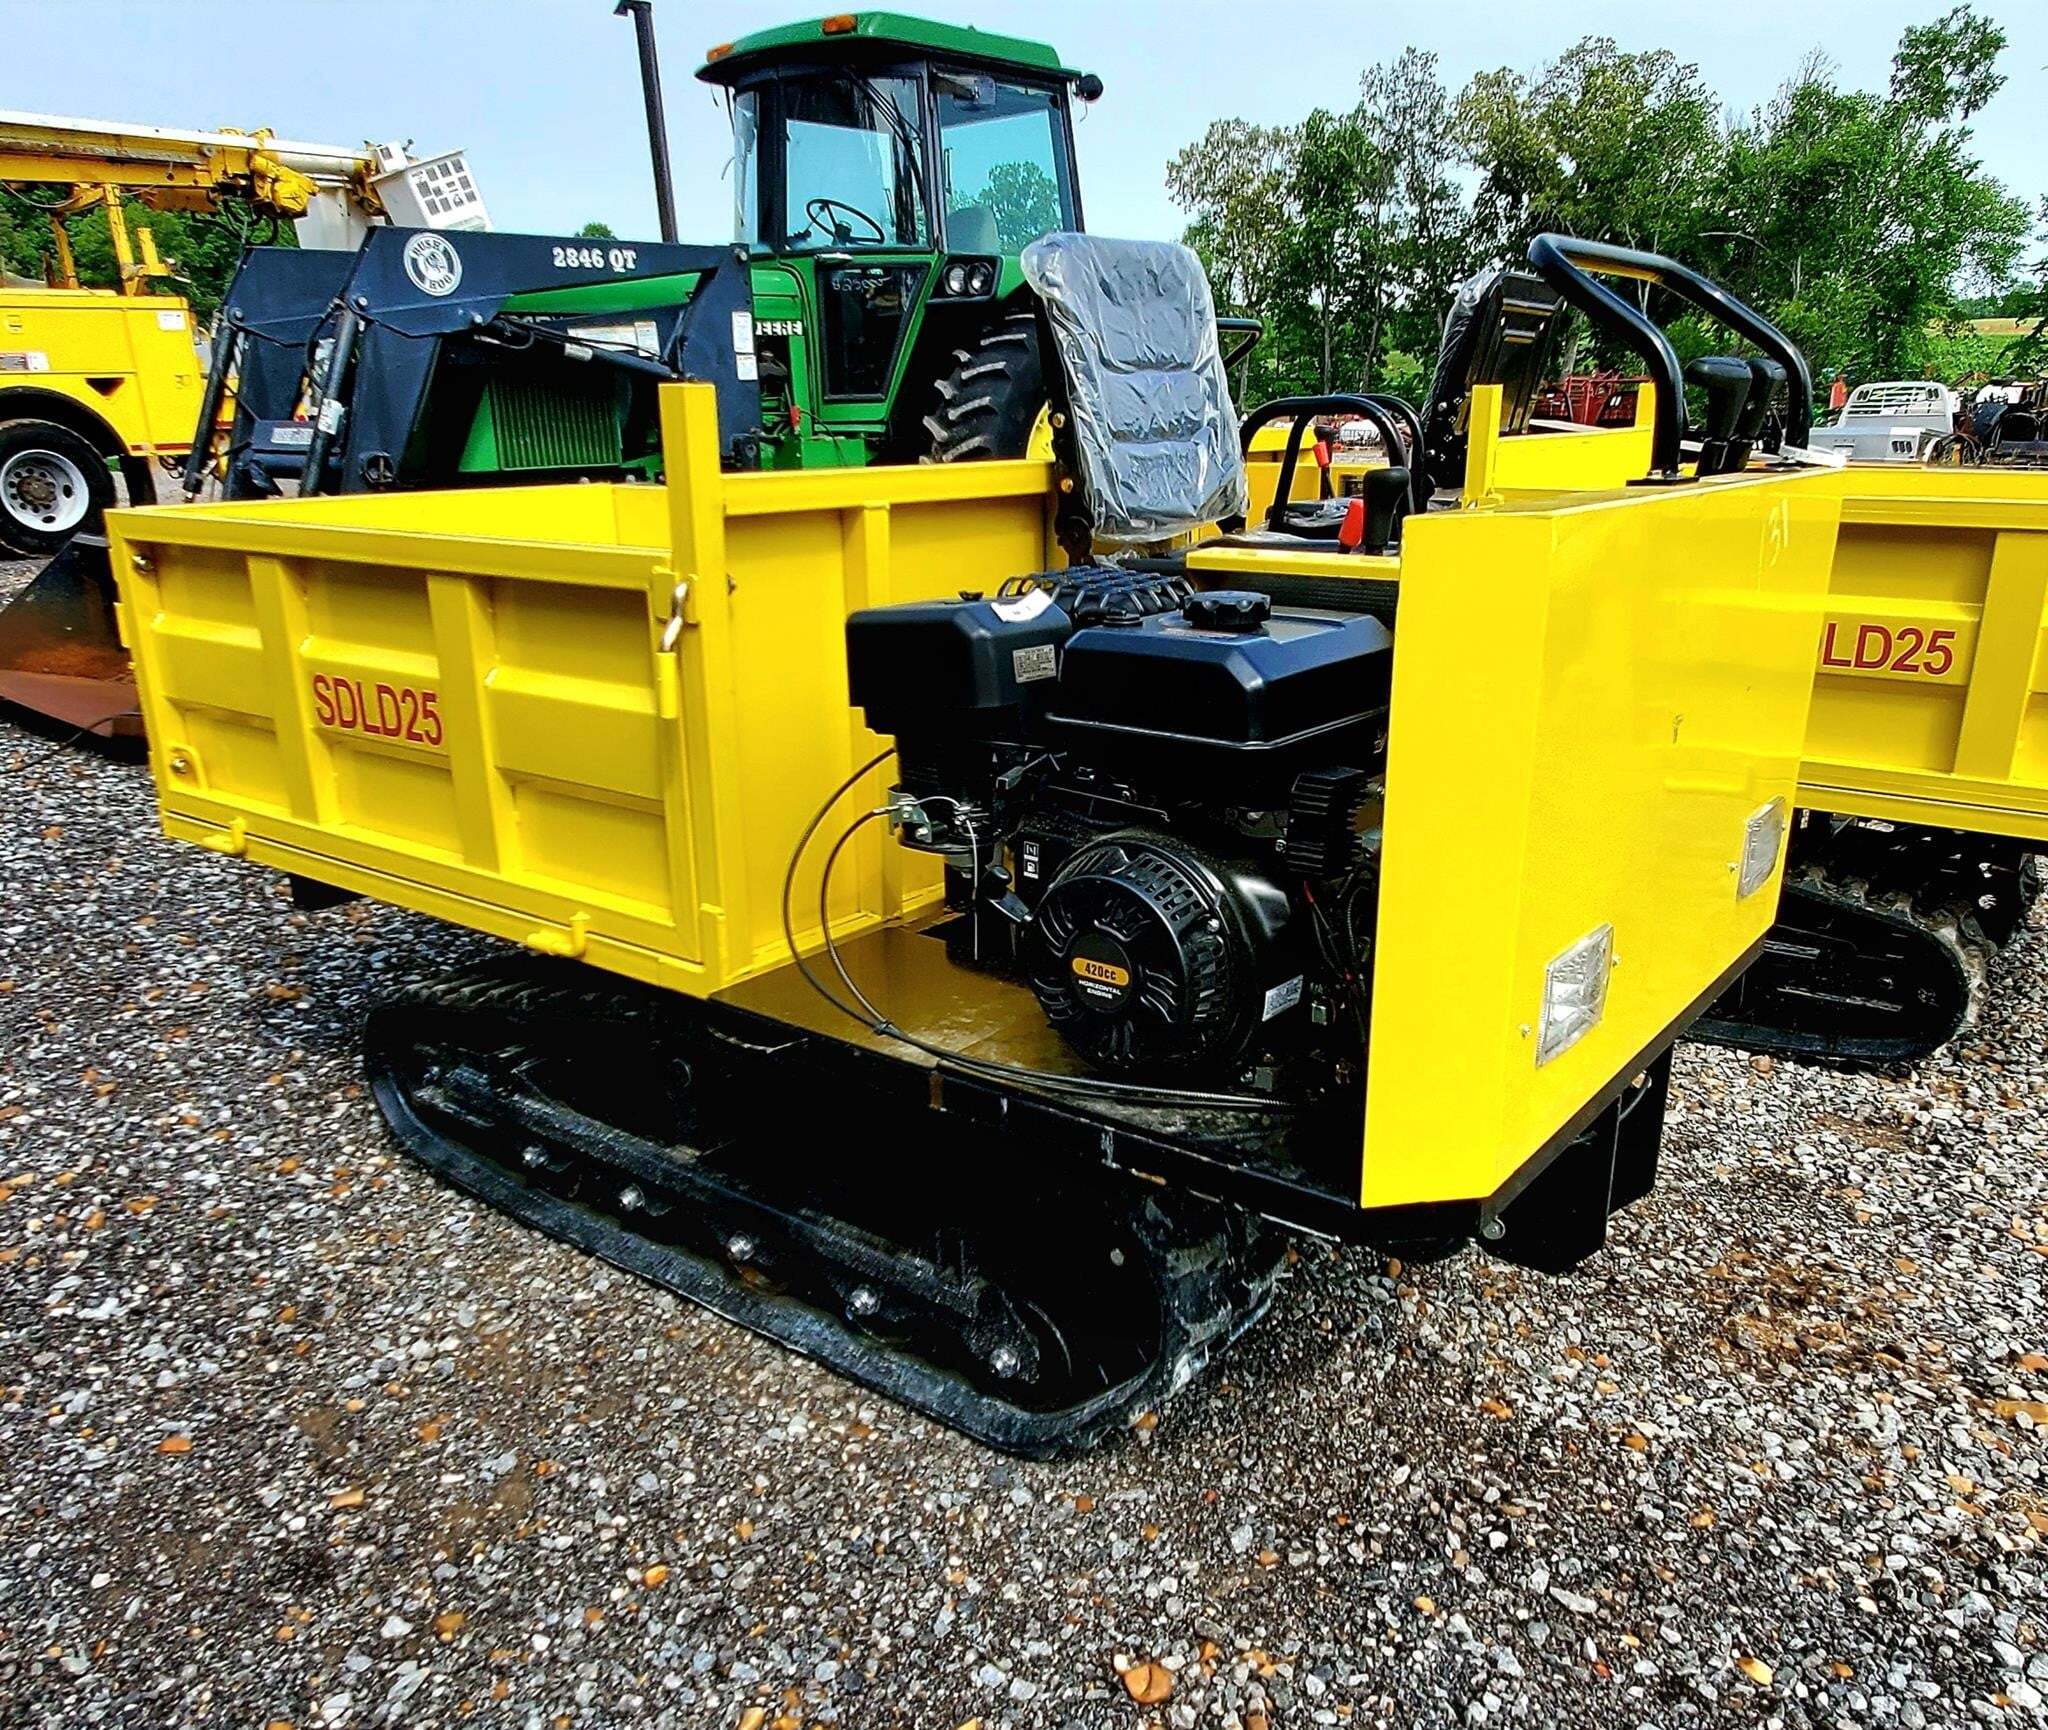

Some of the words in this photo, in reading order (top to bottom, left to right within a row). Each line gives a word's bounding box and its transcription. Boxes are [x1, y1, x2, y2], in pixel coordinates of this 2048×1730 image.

[552, 245, 605, 269] 2846
[608, 248, 637, 273] QT
[1821, 622, 1957, 676] LD25
[313, 674, 443, 746] SDLD25
[1078, 980, 1121, 995] HORIZONTAL
[1087, 988, 1112, 999] ENGINE
